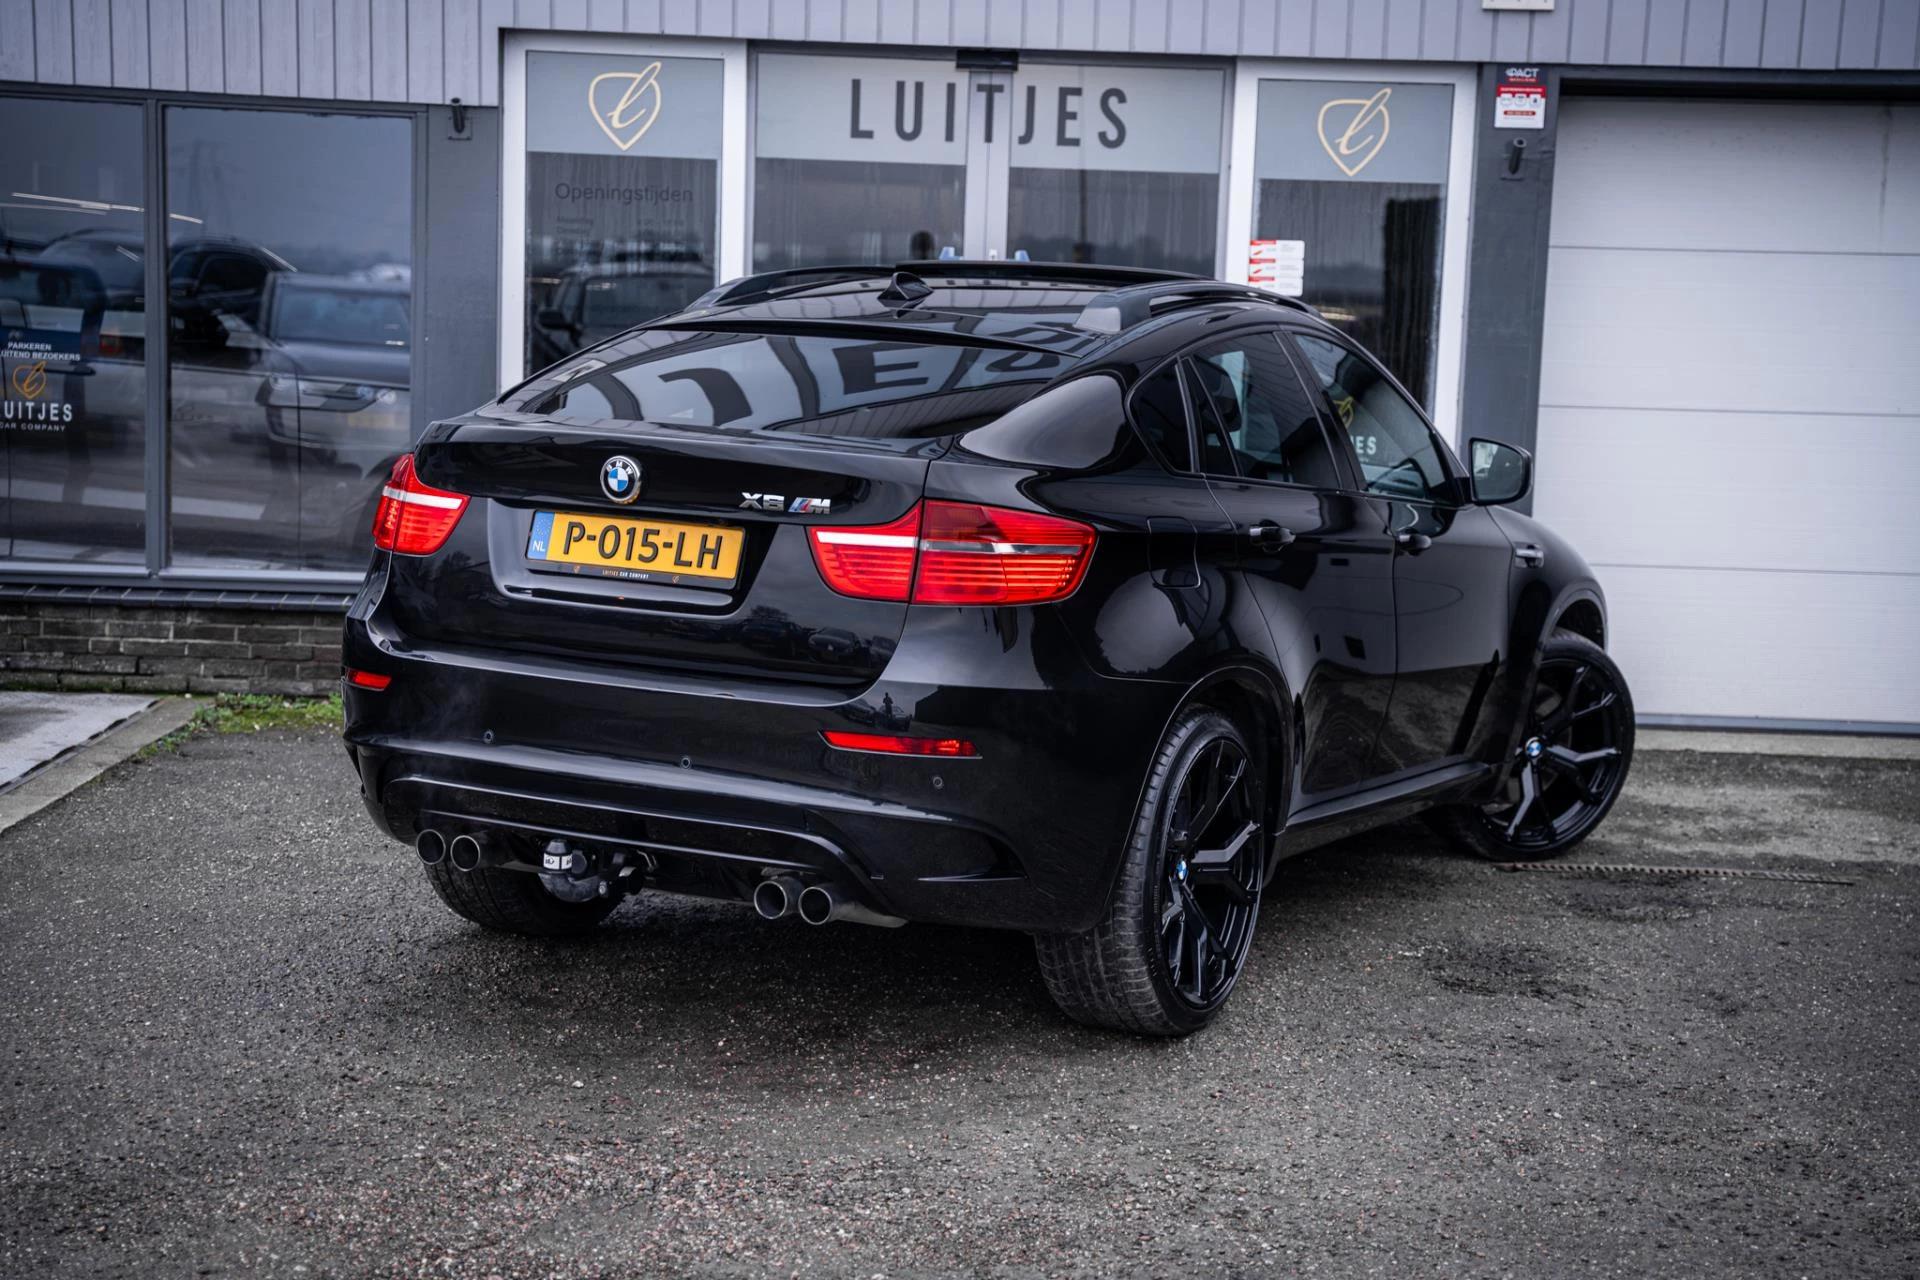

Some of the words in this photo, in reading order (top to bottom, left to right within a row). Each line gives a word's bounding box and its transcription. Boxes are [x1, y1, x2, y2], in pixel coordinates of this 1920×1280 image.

[850, 78, 1128, 149] LUITJES
[555, 182, 694, 205] Openingstijden
[7, 341, 52, 351] PARKEREN
[32, 351, 81, 361] BEZOEKERS
[0, 400, 73, 422] UITJES
[20, 422, 66, 432] COMPANY
[739, 492, 785, 511] X6
[533, 540, 546, 551] NL
[563, 521, 723, 570] P-015-LH
